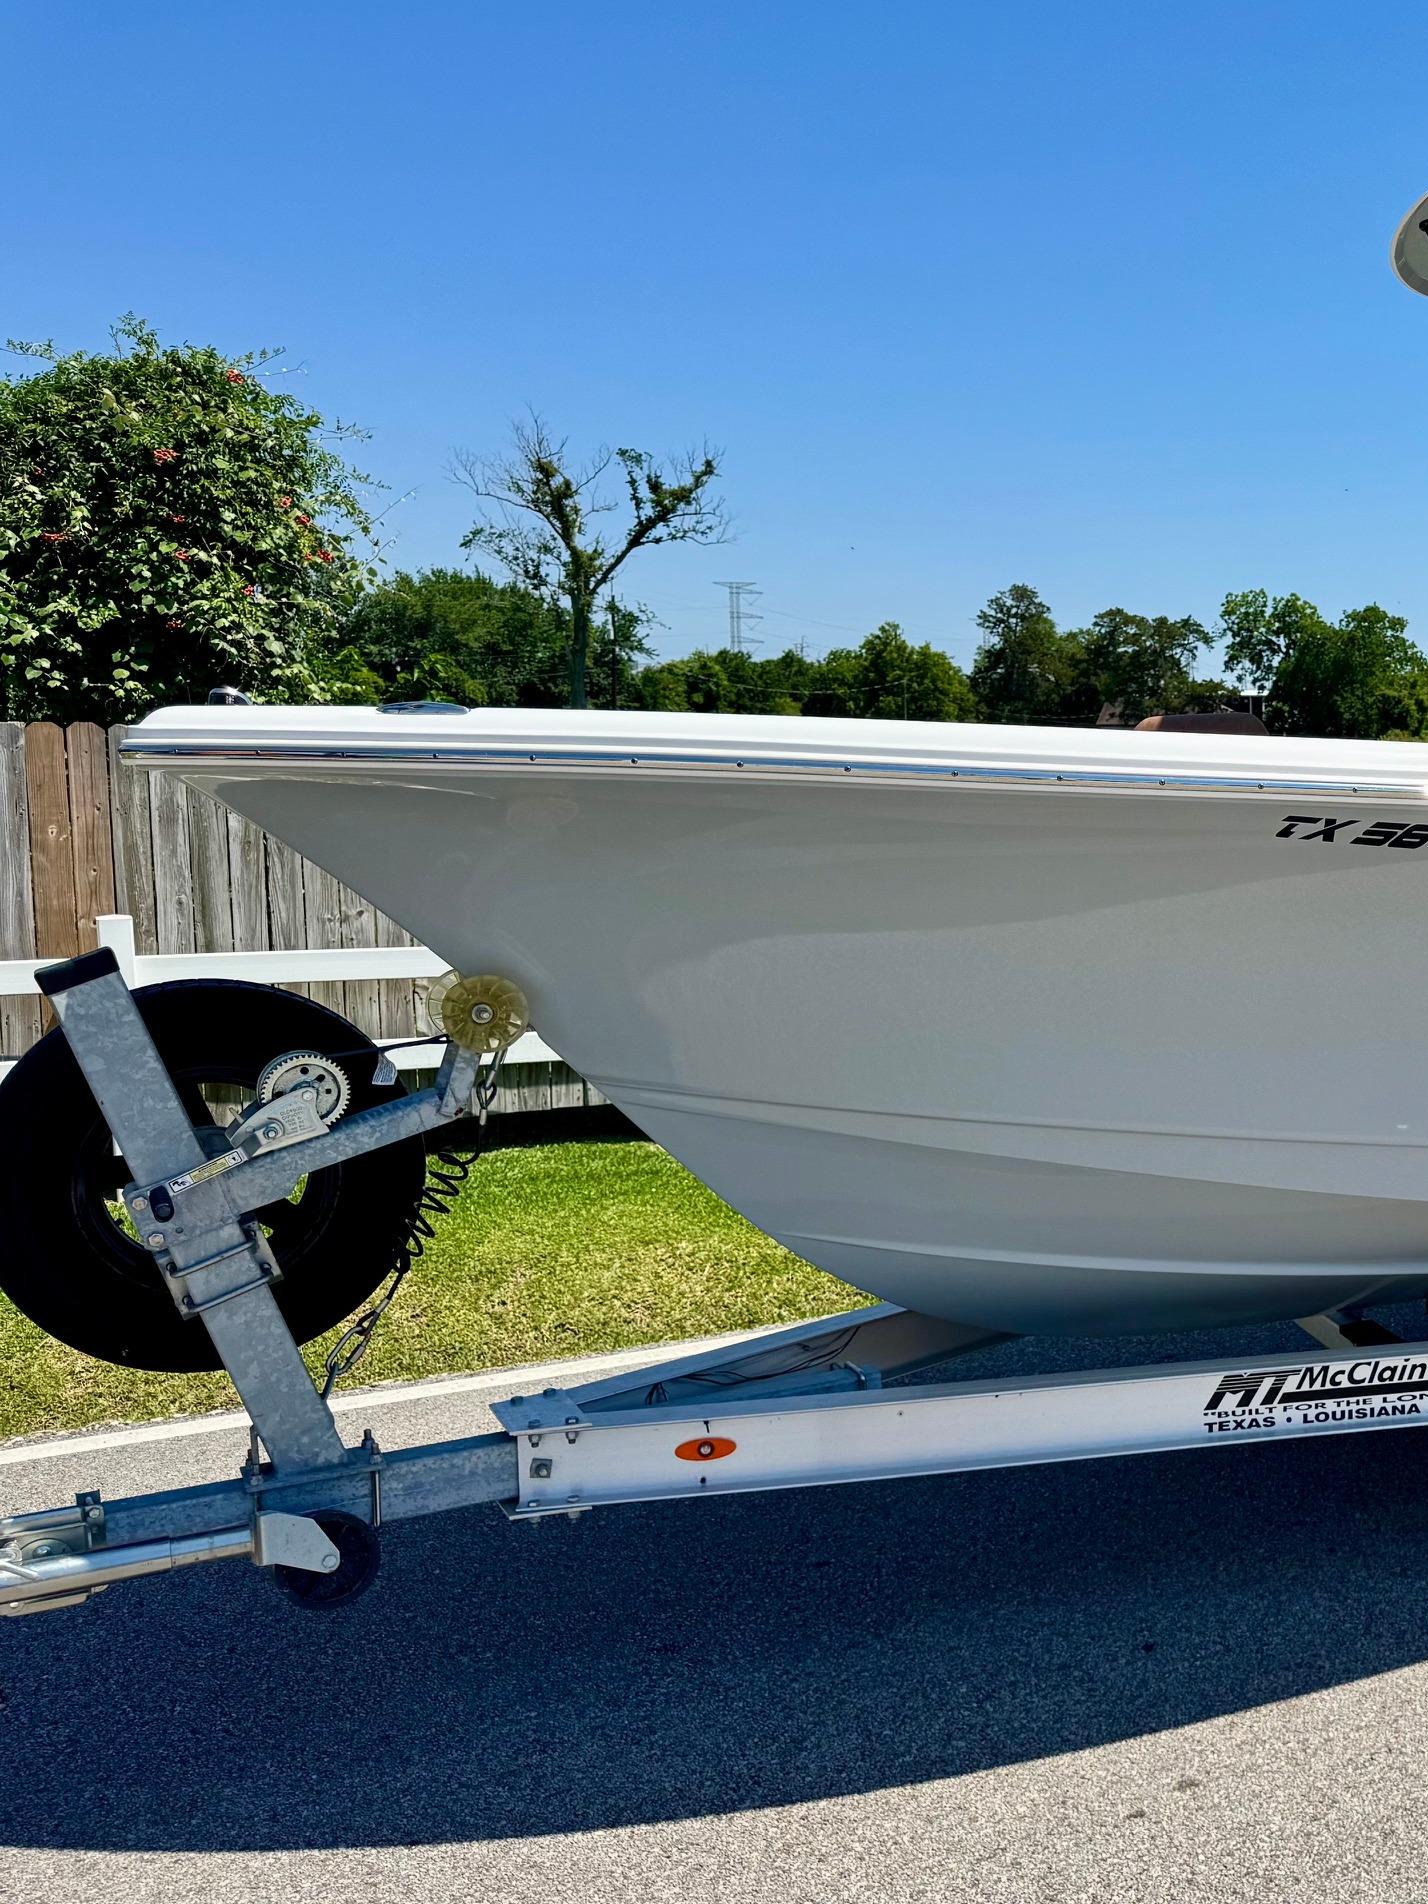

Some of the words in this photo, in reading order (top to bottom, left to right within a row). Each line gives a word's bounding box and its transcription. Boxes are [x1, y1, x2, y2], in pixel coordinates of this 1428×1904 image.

[1275, 815, 1361, 843] TX
[1296, 1358, 1428, 1390] McClain
[1203, 1416, 1276, 1433] TEXAS
[1302, 1403, 1421, 1424] LOUISIANA
[1283, 1402, 1327, 1413] FOR
[1333, 1397, 1373, 1408] THE
